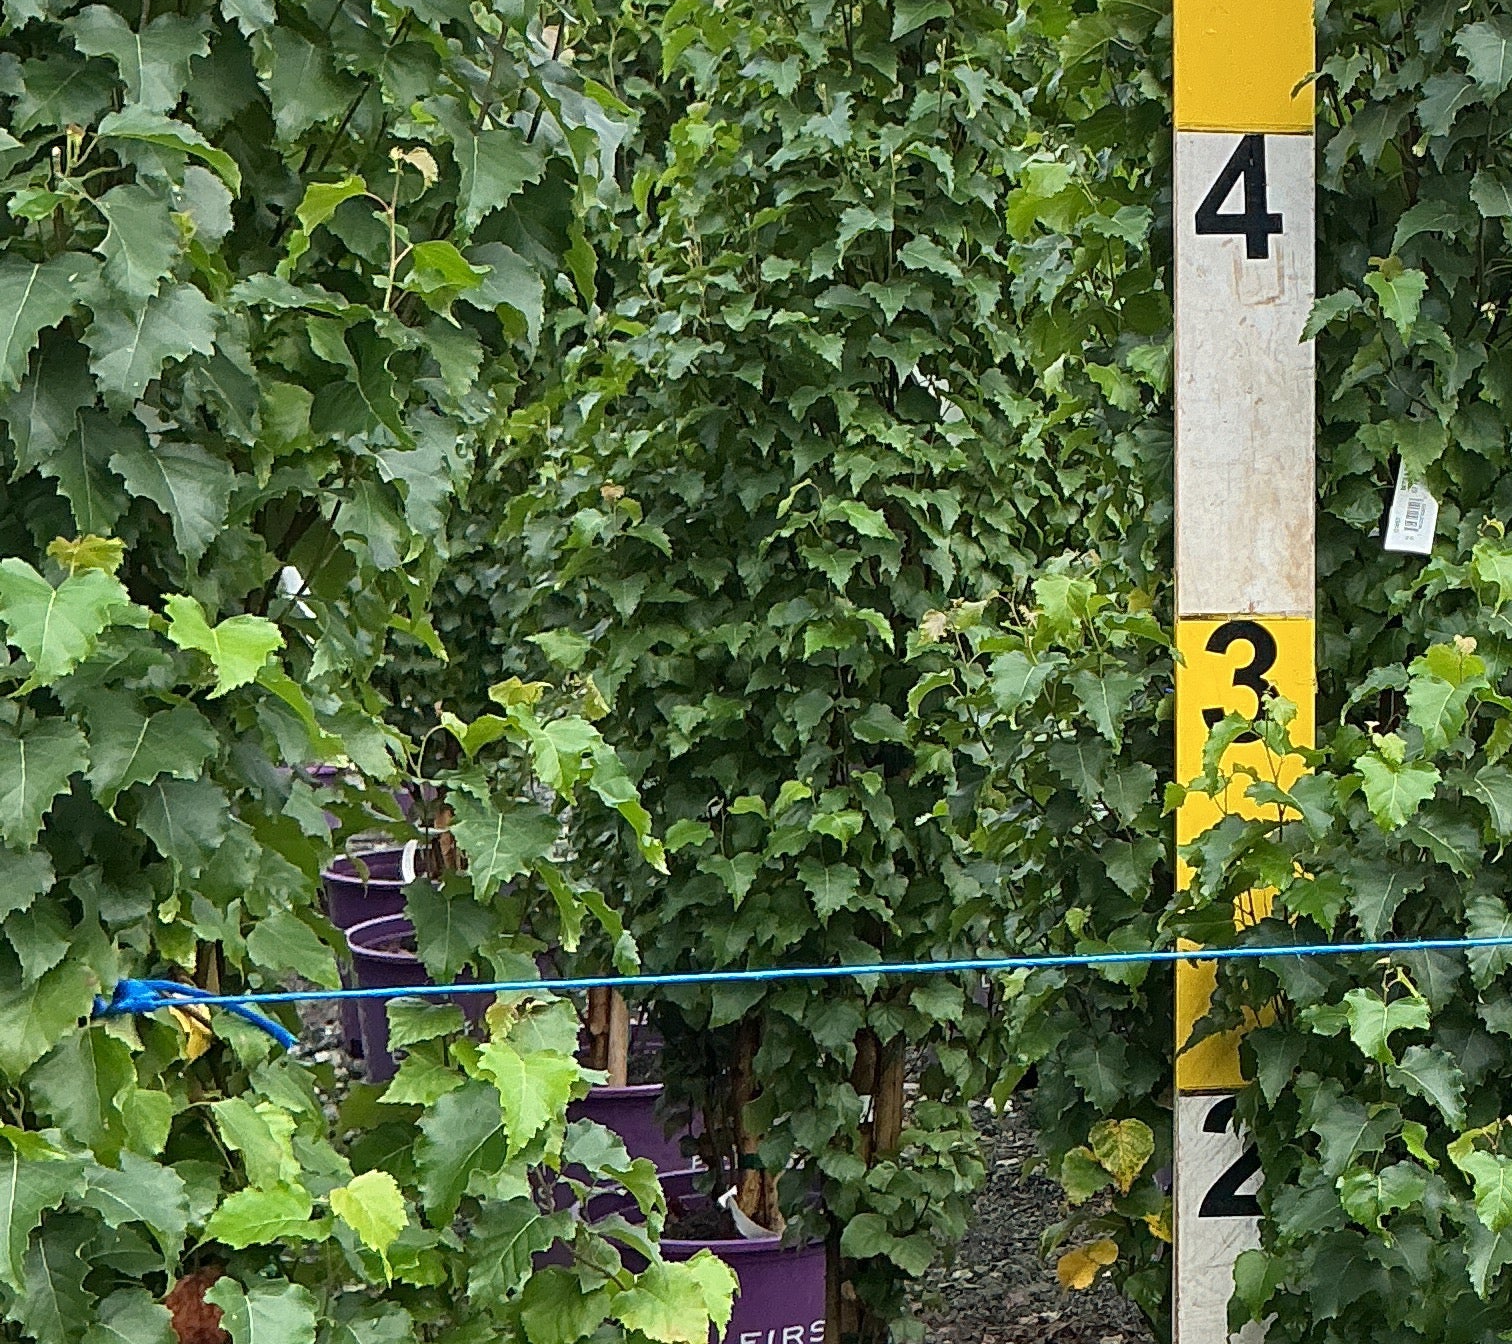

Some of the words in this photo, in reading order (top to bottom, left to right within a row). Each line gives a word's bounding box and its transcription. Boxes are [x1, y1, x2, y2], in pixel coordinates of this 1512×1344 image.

[1195, 134, 1283, 260] 4
[1201, 619, 1280, 744] 3
[1198, 1096, 1267, 1218] 2
